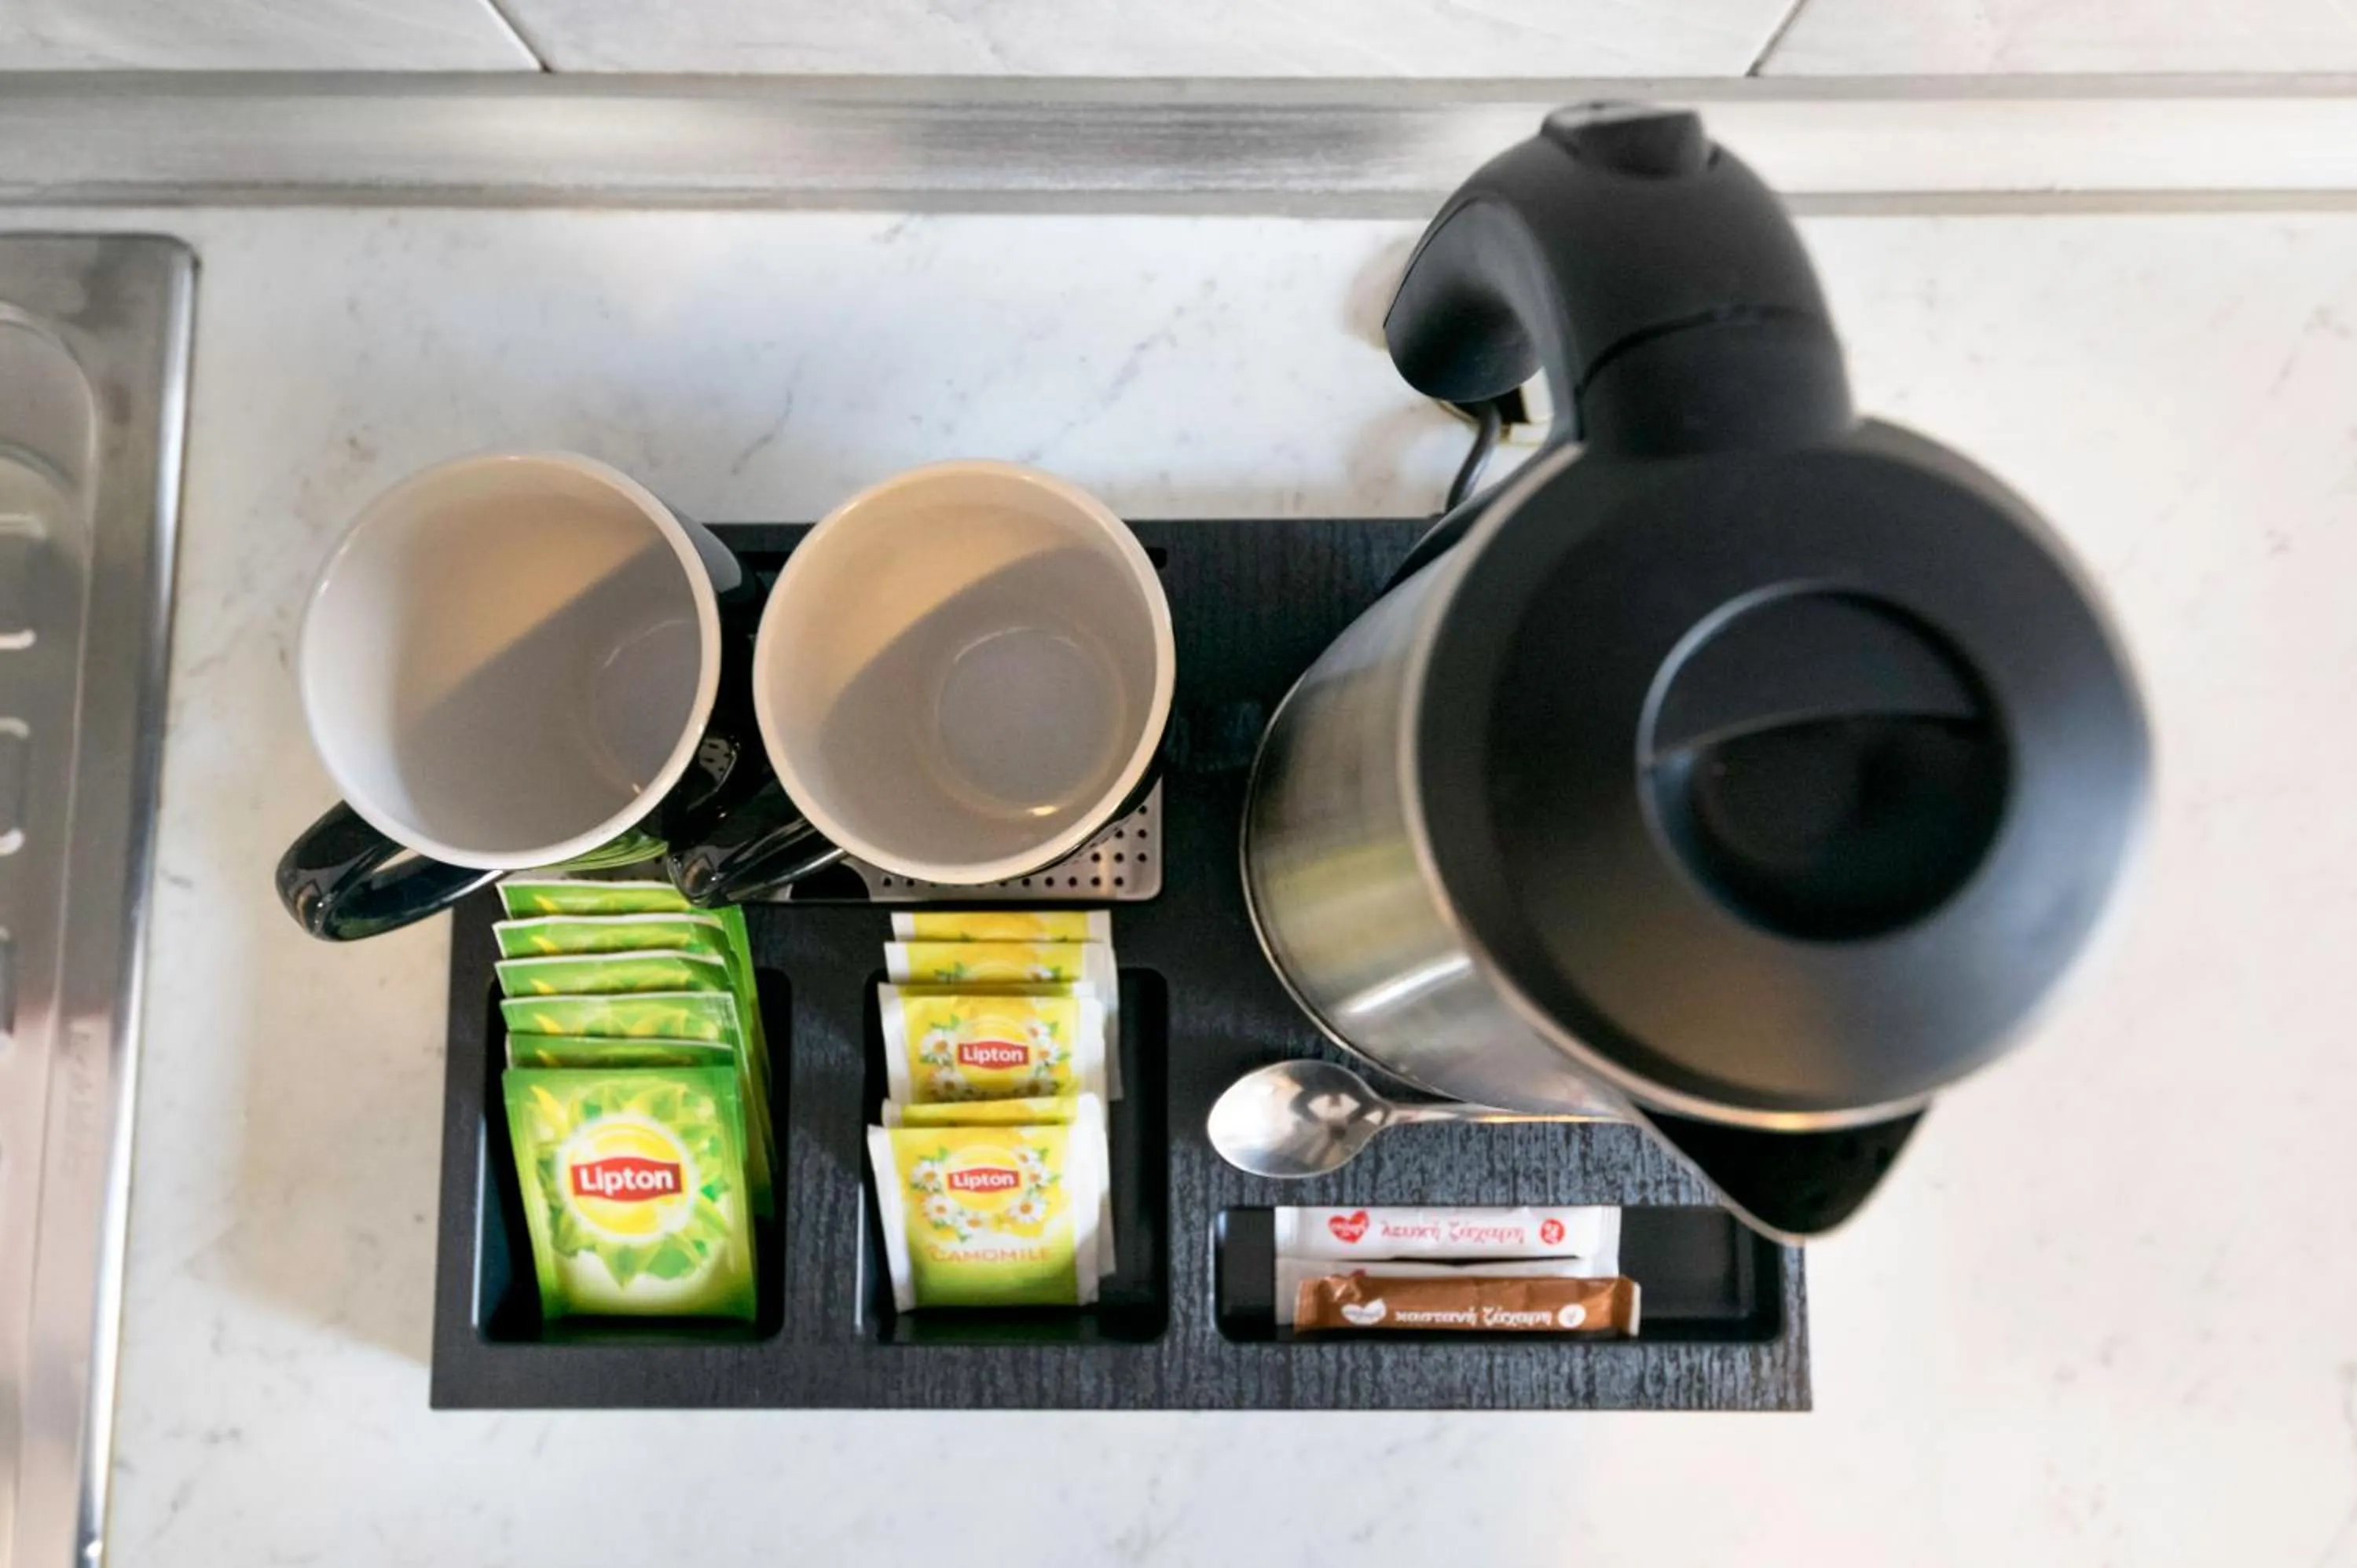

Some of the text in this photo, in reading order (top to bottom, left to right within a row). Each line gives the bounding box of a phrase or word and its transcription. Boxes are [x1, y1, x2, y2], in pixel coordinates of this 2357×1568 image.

[962, 1046, 1024, 1064] Lipton
[578, 1165, 675, 1196] Lipton
[952, 1172, 1016, 1190] Lipton
[929, 1246, 1050, 1262] CAMOMILE
